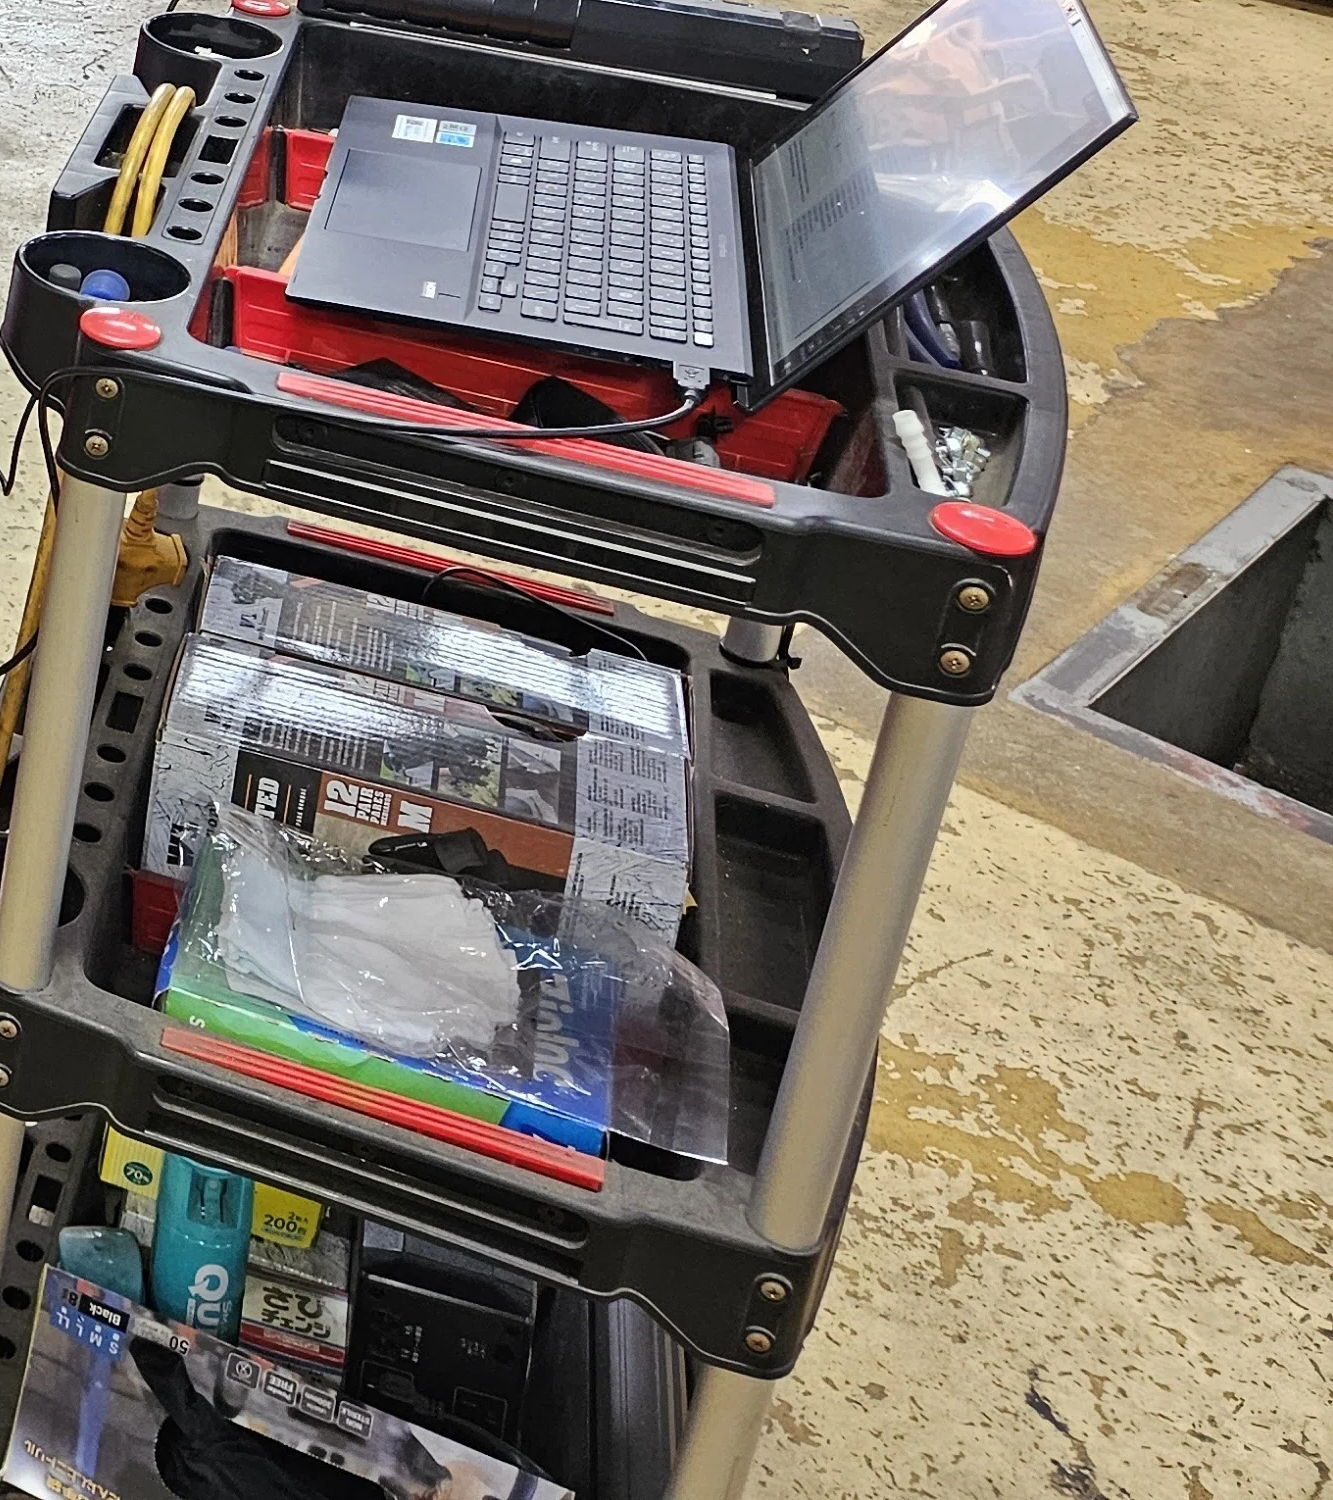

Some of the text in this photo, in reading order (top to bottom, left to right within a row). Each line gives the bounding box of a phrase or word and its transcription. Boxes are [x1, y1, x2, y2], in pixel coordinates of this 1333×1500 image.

[323, 779, 359, 817] 12
[356, 787, 374, 822] PAIR
[369, 790, 385, 825] PARES
[397, 800, 433, 833] M
[89, 1302, 121, 1326] Black
[261, 1308, 331, 1339] チェンジ
[89, 1331, 103, 1347] M
[169, 1336, 189, 1355] 50
[268, 1374, 294, 1392] FREE
